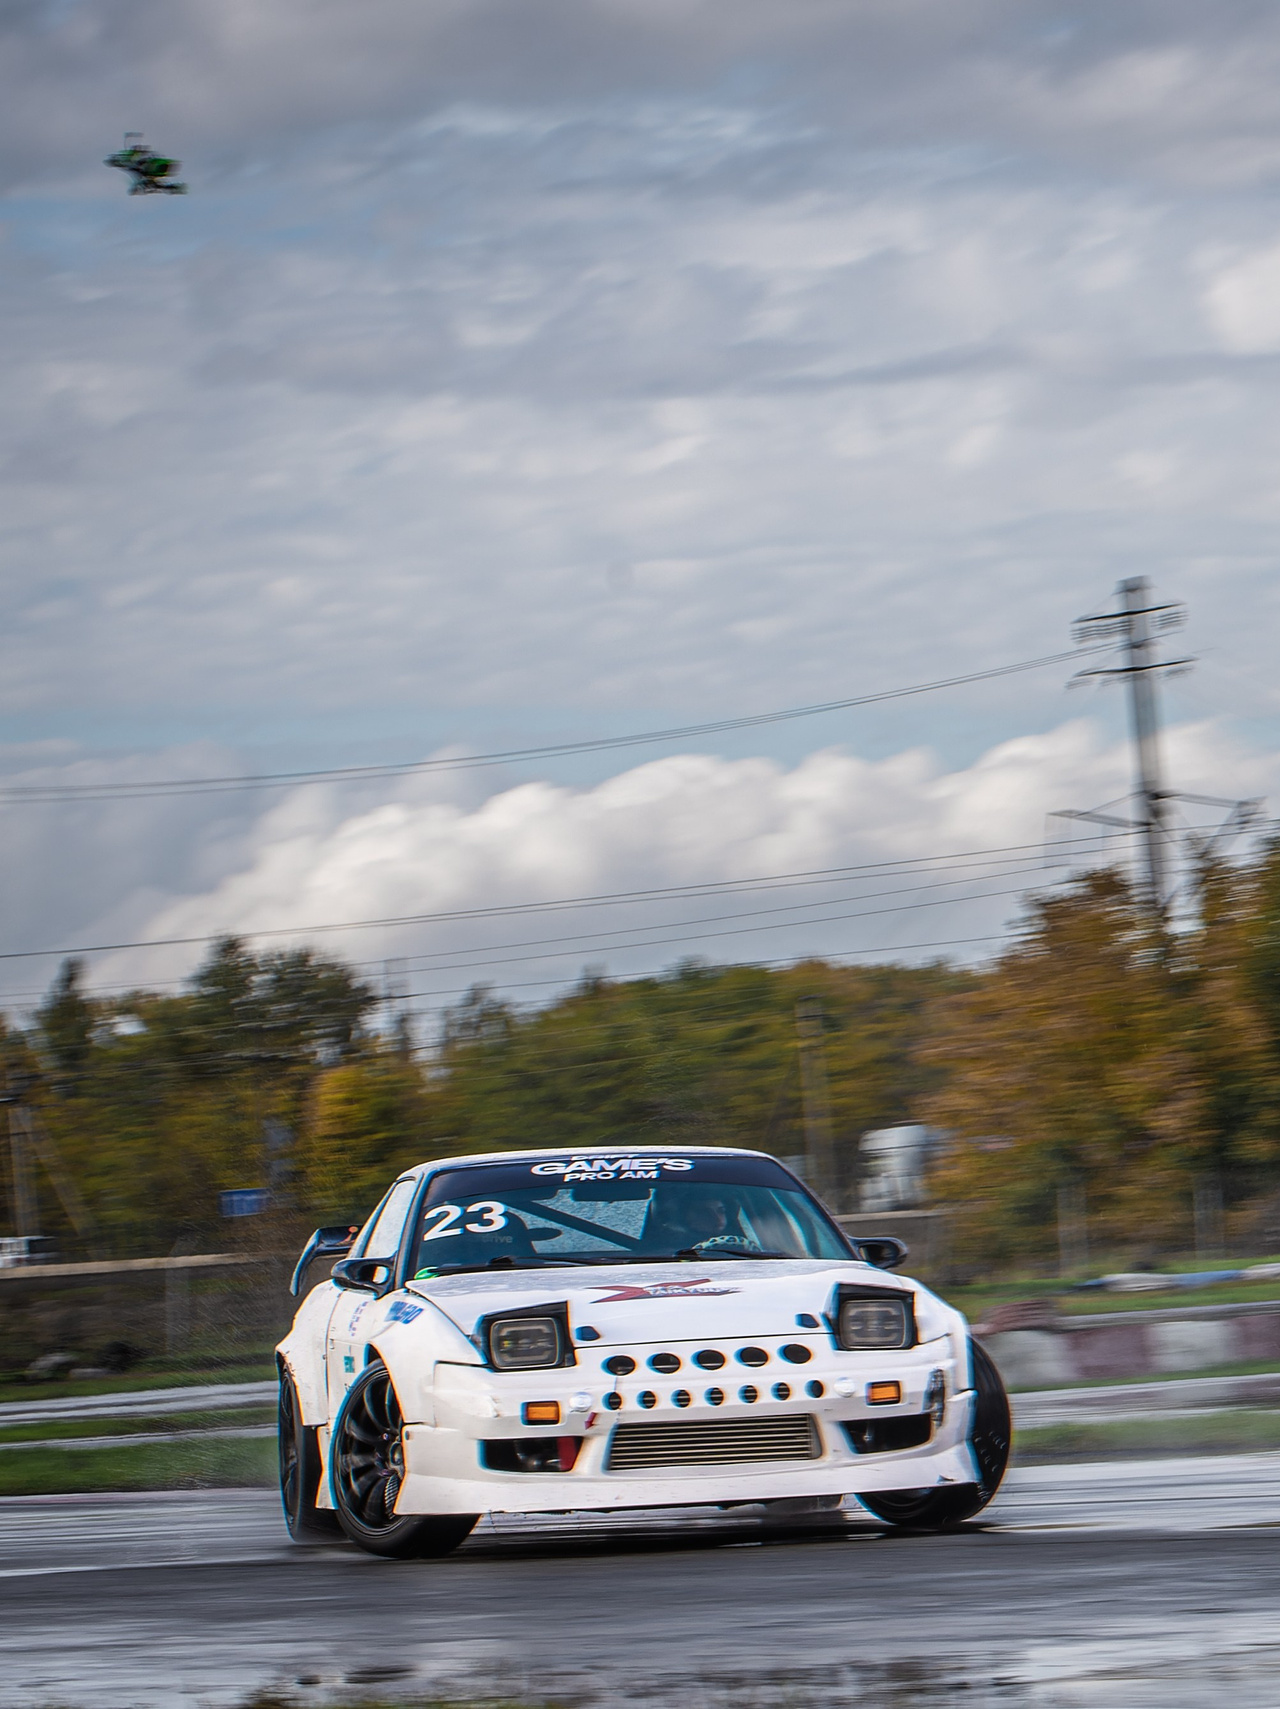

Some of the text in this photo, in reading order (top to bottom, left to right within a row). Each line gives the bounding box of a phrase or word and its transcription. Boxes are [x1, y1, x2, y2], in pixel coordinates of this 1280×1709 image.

[531, 1157, 695, 1176] GAME'S
[563, 1170, 661, 1182] PRO AM
[423, 1200, 509, 1241] 23
